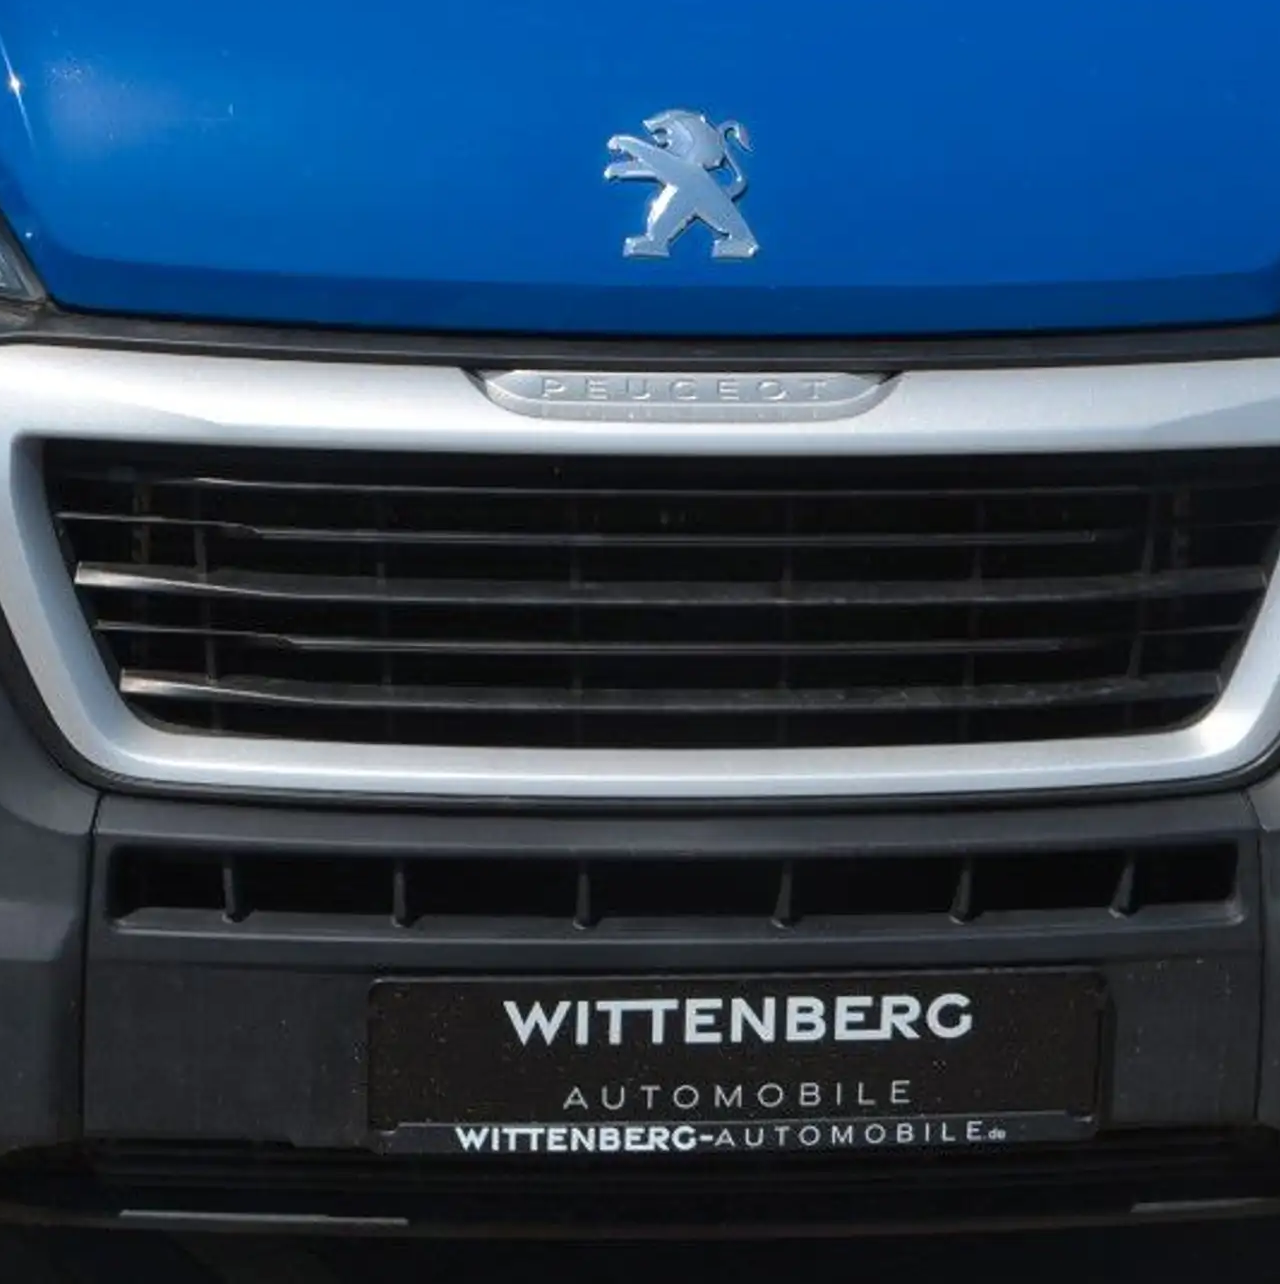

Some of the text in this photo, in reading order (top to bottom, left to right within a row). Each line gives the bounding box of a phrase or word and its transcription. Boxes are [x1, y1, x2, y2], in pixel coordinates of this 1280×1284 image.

[540, 376, 828, 401] PEUGEOT
[503, 993, 974, 1046] WITTENBERG
[562, 1079, 913, 1111] AUTOMOBILE
[455, 1120, 1008, 1153] WITTENBERG-AUTOMOBILE.de
